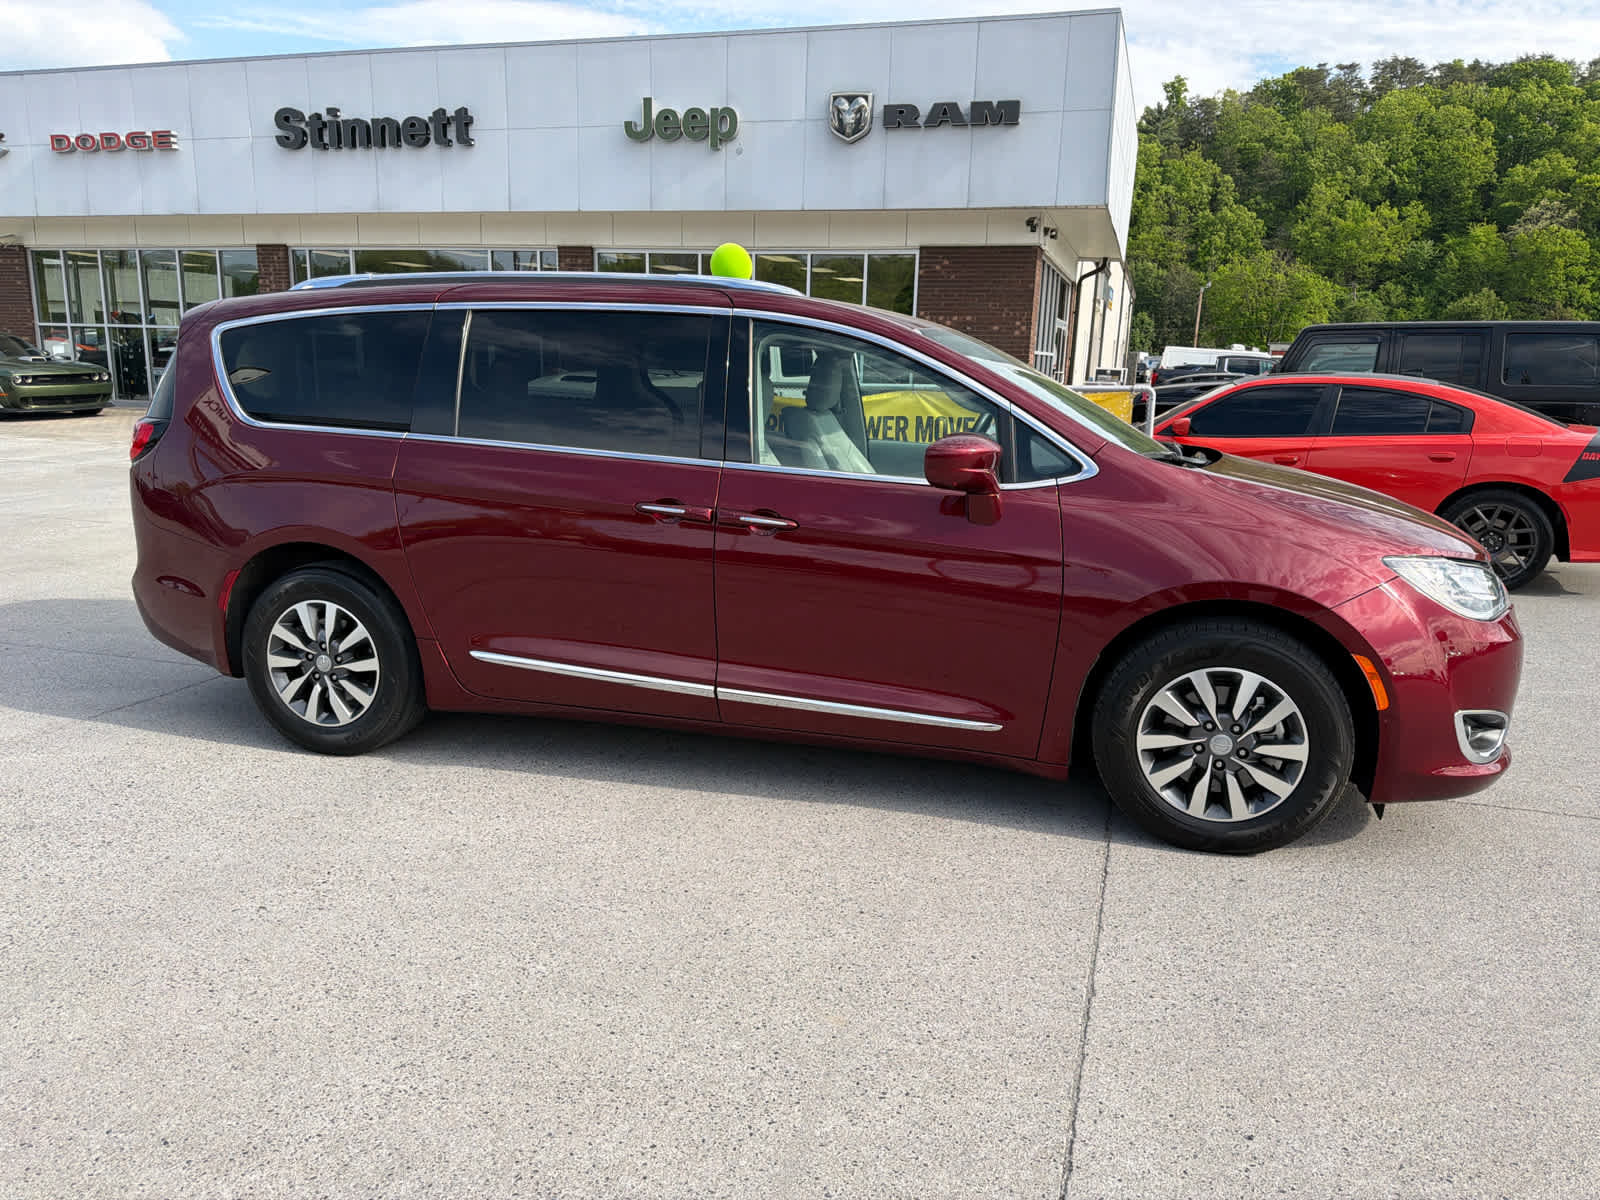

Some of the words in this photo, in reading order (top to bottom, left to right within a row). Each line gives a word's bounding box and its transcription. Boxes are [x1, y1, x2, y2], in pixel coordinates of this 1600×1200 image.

[274, 106, 475, 150] Stinnett
[623, 96, 739, 151] Jeep
[883, 99, 1021, 129] RAM
[50, 129, 178, 154] DODGE
[864, 415, 908, 442] WER
